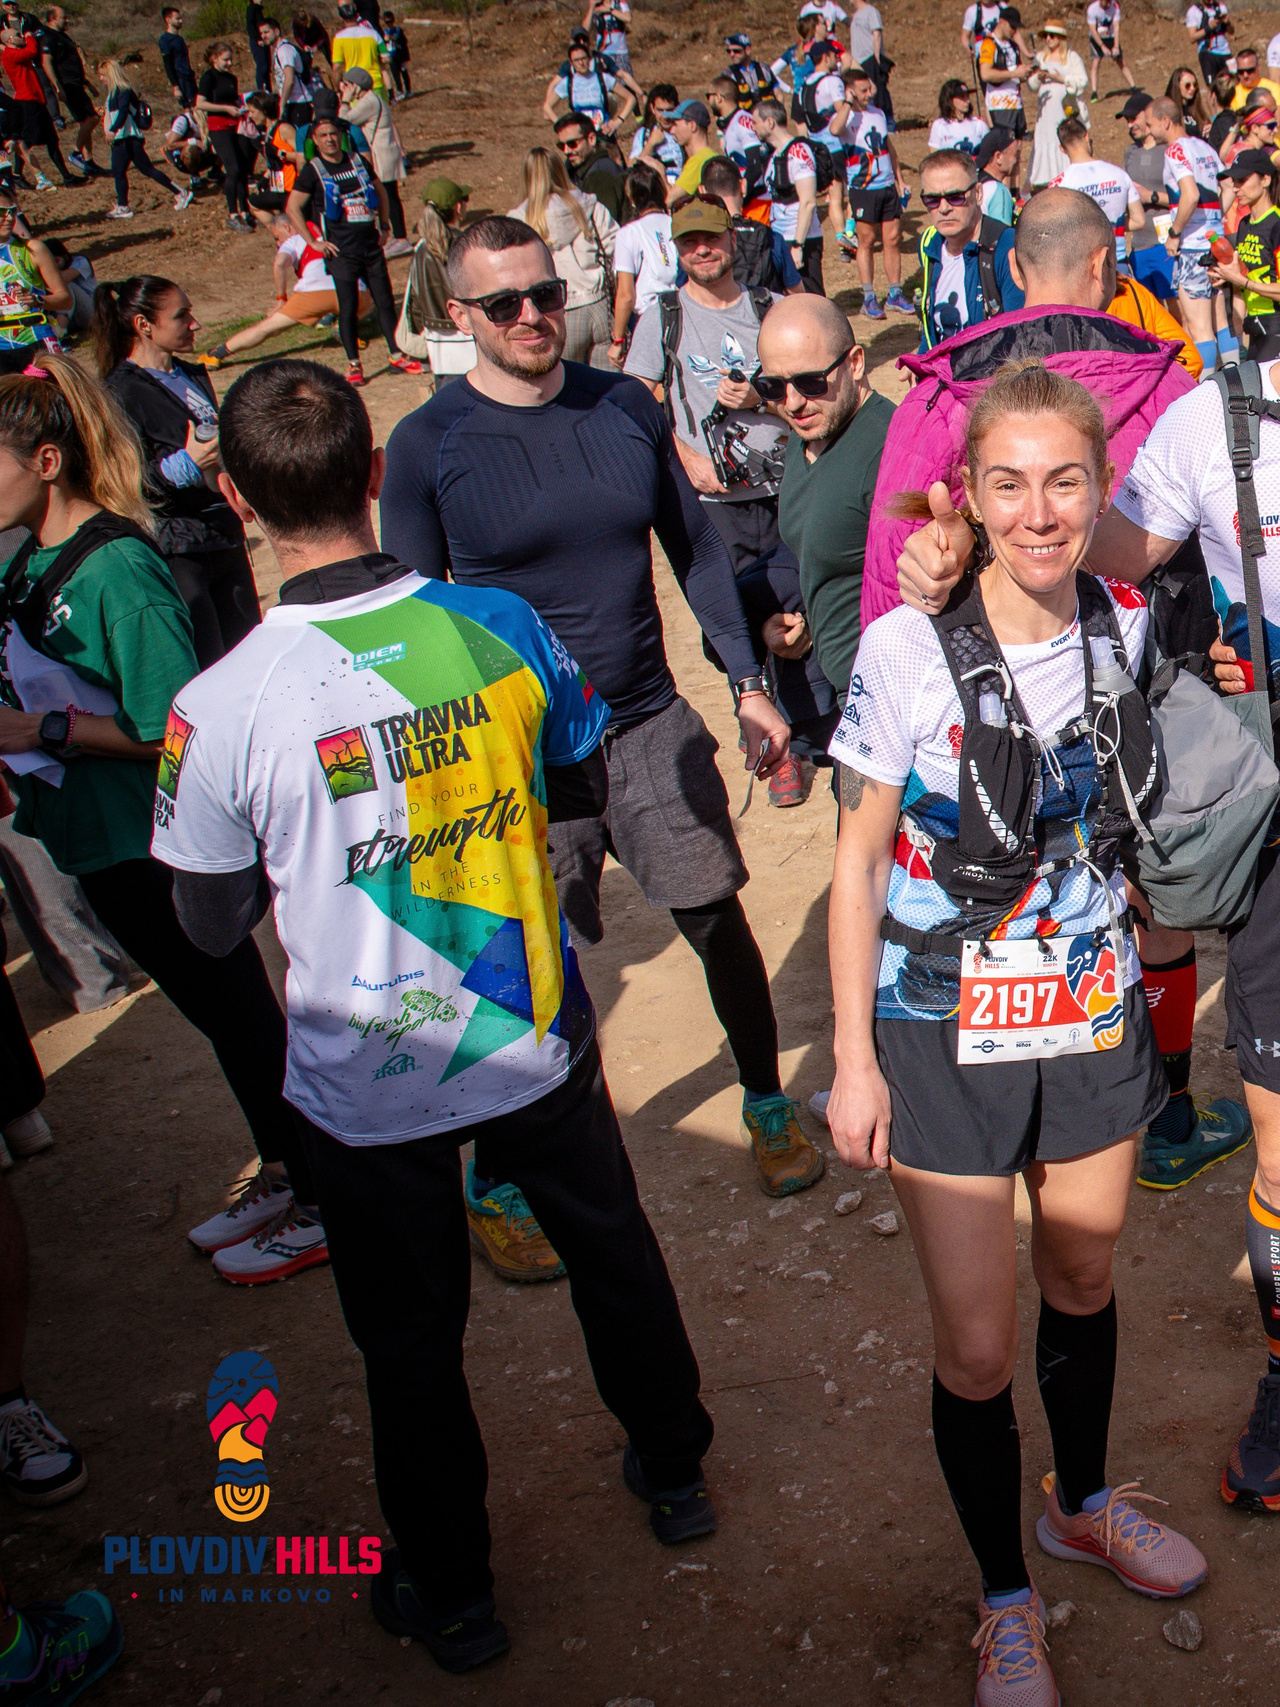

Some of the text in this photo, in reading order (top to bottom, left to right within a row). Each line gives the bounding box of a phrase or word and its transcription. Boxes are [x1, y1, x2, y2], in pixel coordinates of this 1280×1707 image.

[1091, 186, 1122, 197] MATTERS
[1100, 180, 1117, 189] STEP
[356, 643, 403, 664] DIEM
[1051, 633, 1070, 648] EVERY
[358, 655, 402, 670] SPORT
[371, 692, 491, 752] TRYAVNA
[386, 732, 472, 783] ULTRA
[859, 742, 873, 753] 22K
[378, 783, 478, 826] FIND YOUR
[334, 787, 526, 887] strength
[413, 862, 470, 894] IN THE
[391, 873, 501, 919] WILDERNESS
[351, 970, 425, 991] Aurubis
[970, 981, 1059, 1026] 2197
[481, 1217, 509, 1252] HOKA
